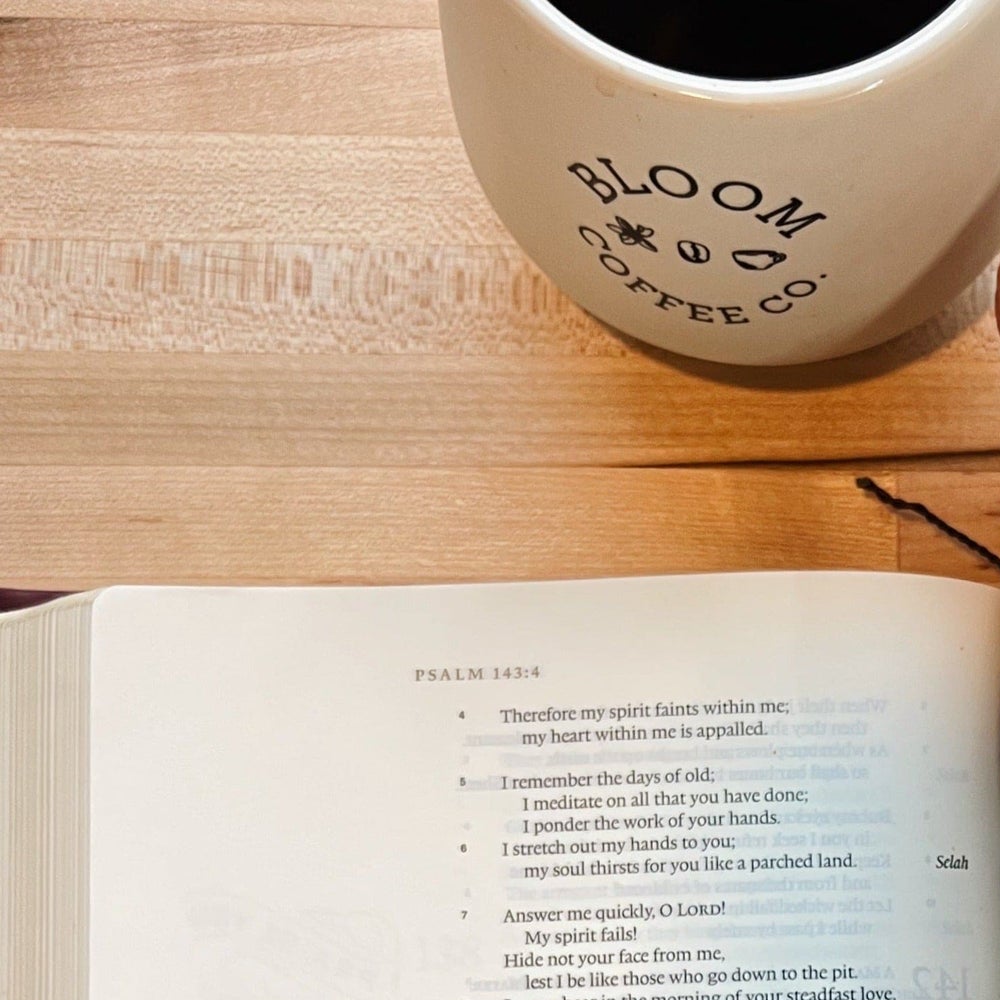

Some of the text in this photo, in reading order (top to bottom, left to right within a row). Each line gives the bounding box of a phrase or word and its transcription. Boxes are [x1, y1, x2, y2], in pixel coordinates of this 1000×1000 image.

[567, 157, 827, 239] BLOOM
[578, 225, 827, 325] COFFEE CO.
[415, 666, 540, 682] PSALM 143:4
[458, 711, 465, 719] 4
[500, 707, 576, 723] Therefore
[581, 709, 605, 722] my
[609, 706, 650, 721] spirit
[655, 702, 699, 717] faints
[703, 700, 755, 714] within
[760, 702, 789, 715] me;
[460, 767, 715, 790] 5 I remember the days of old;
[524, 853, 857, 881] my soul thirsts for you like a parched land.
[935, 854, 969, 870] Selah
[461, 910, 468, 919] 7
[504, 910, 564, 923] Answer
[567, 909, 592, 921] me
[595, 903, 655, 923] quickly,
[659, 904, 673, 918] O
[678, 901, 725, 917] LORD!
[860, 986, 896, 1000] love,
